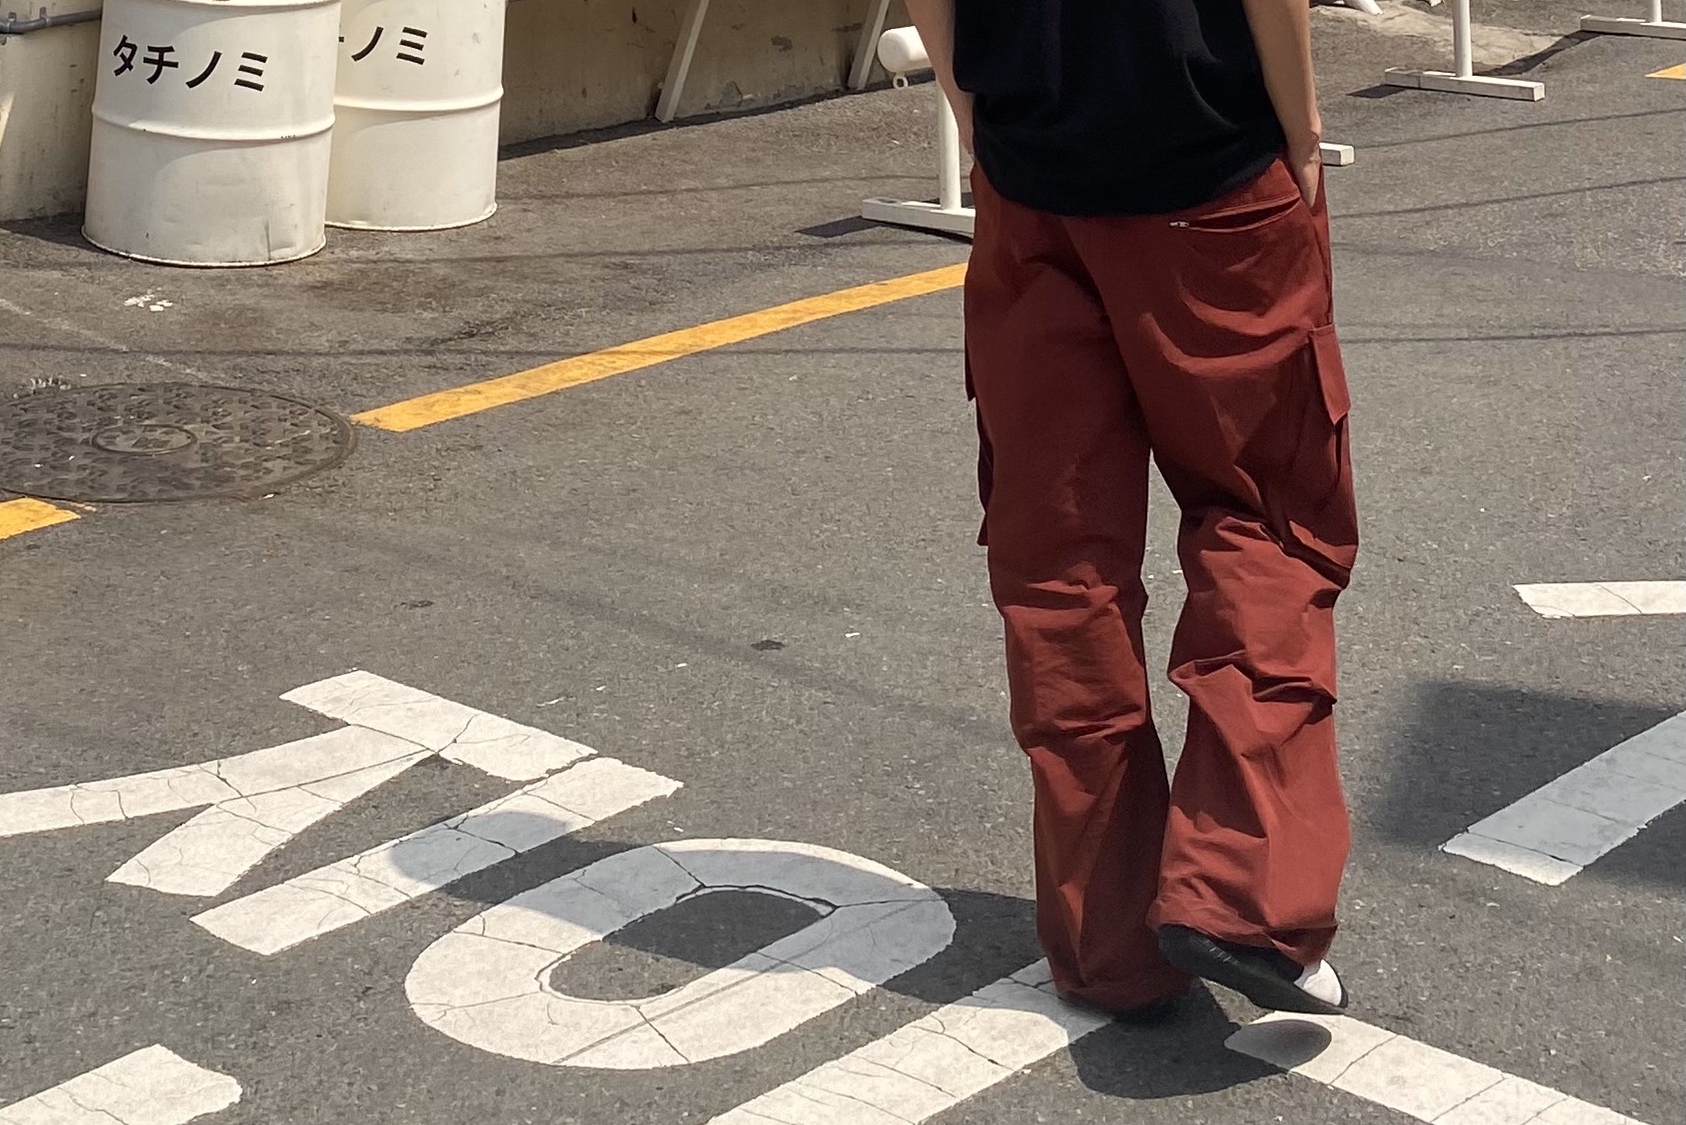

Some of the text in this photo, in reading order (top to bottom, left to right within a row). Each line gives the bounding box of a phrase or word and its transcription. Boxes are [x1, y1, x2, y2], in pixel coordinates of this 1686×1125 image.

[112, 34, 268, 92] タチノミ
[338, 26, 428, 65] ノミ
